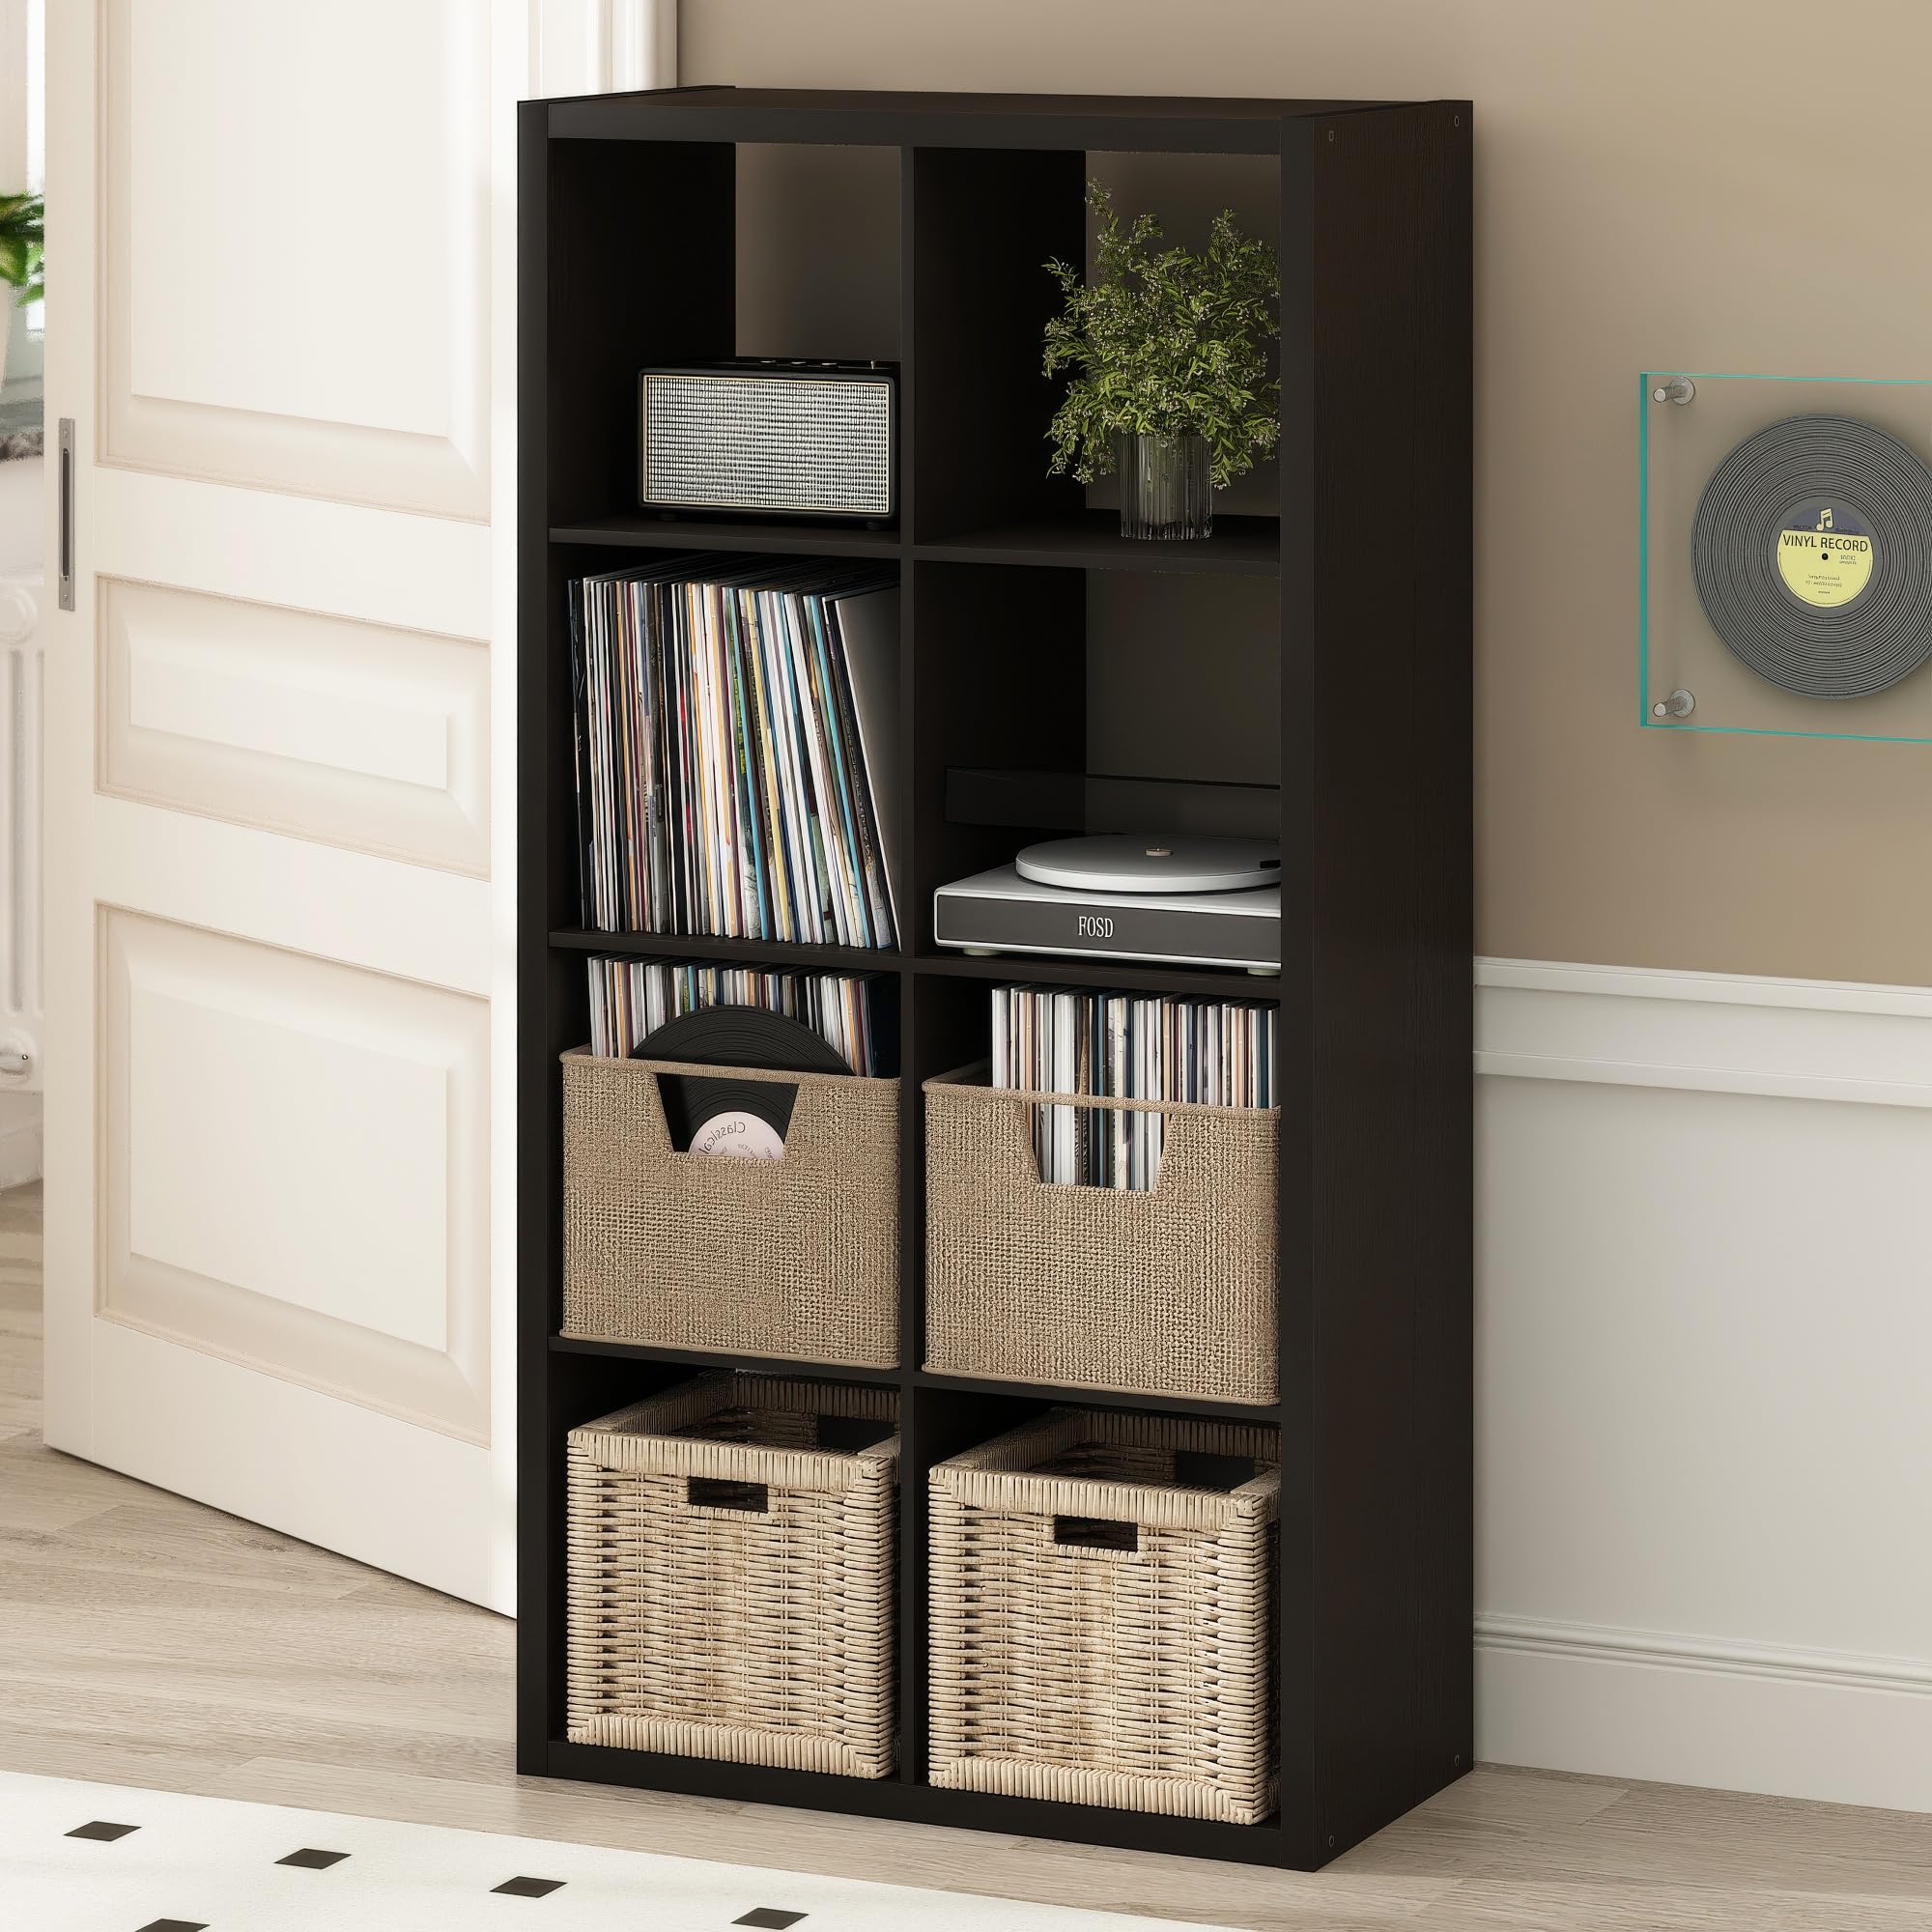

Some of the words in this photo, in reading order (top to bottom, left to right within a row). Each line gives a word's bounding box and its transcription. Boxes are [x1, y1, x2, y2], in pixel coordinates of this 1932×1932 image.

[1783, 534, 1817, 548] VINYL
[1820, 537, 1868, 552] RECORD
[1078, 916, 1113, 938] FOSD
